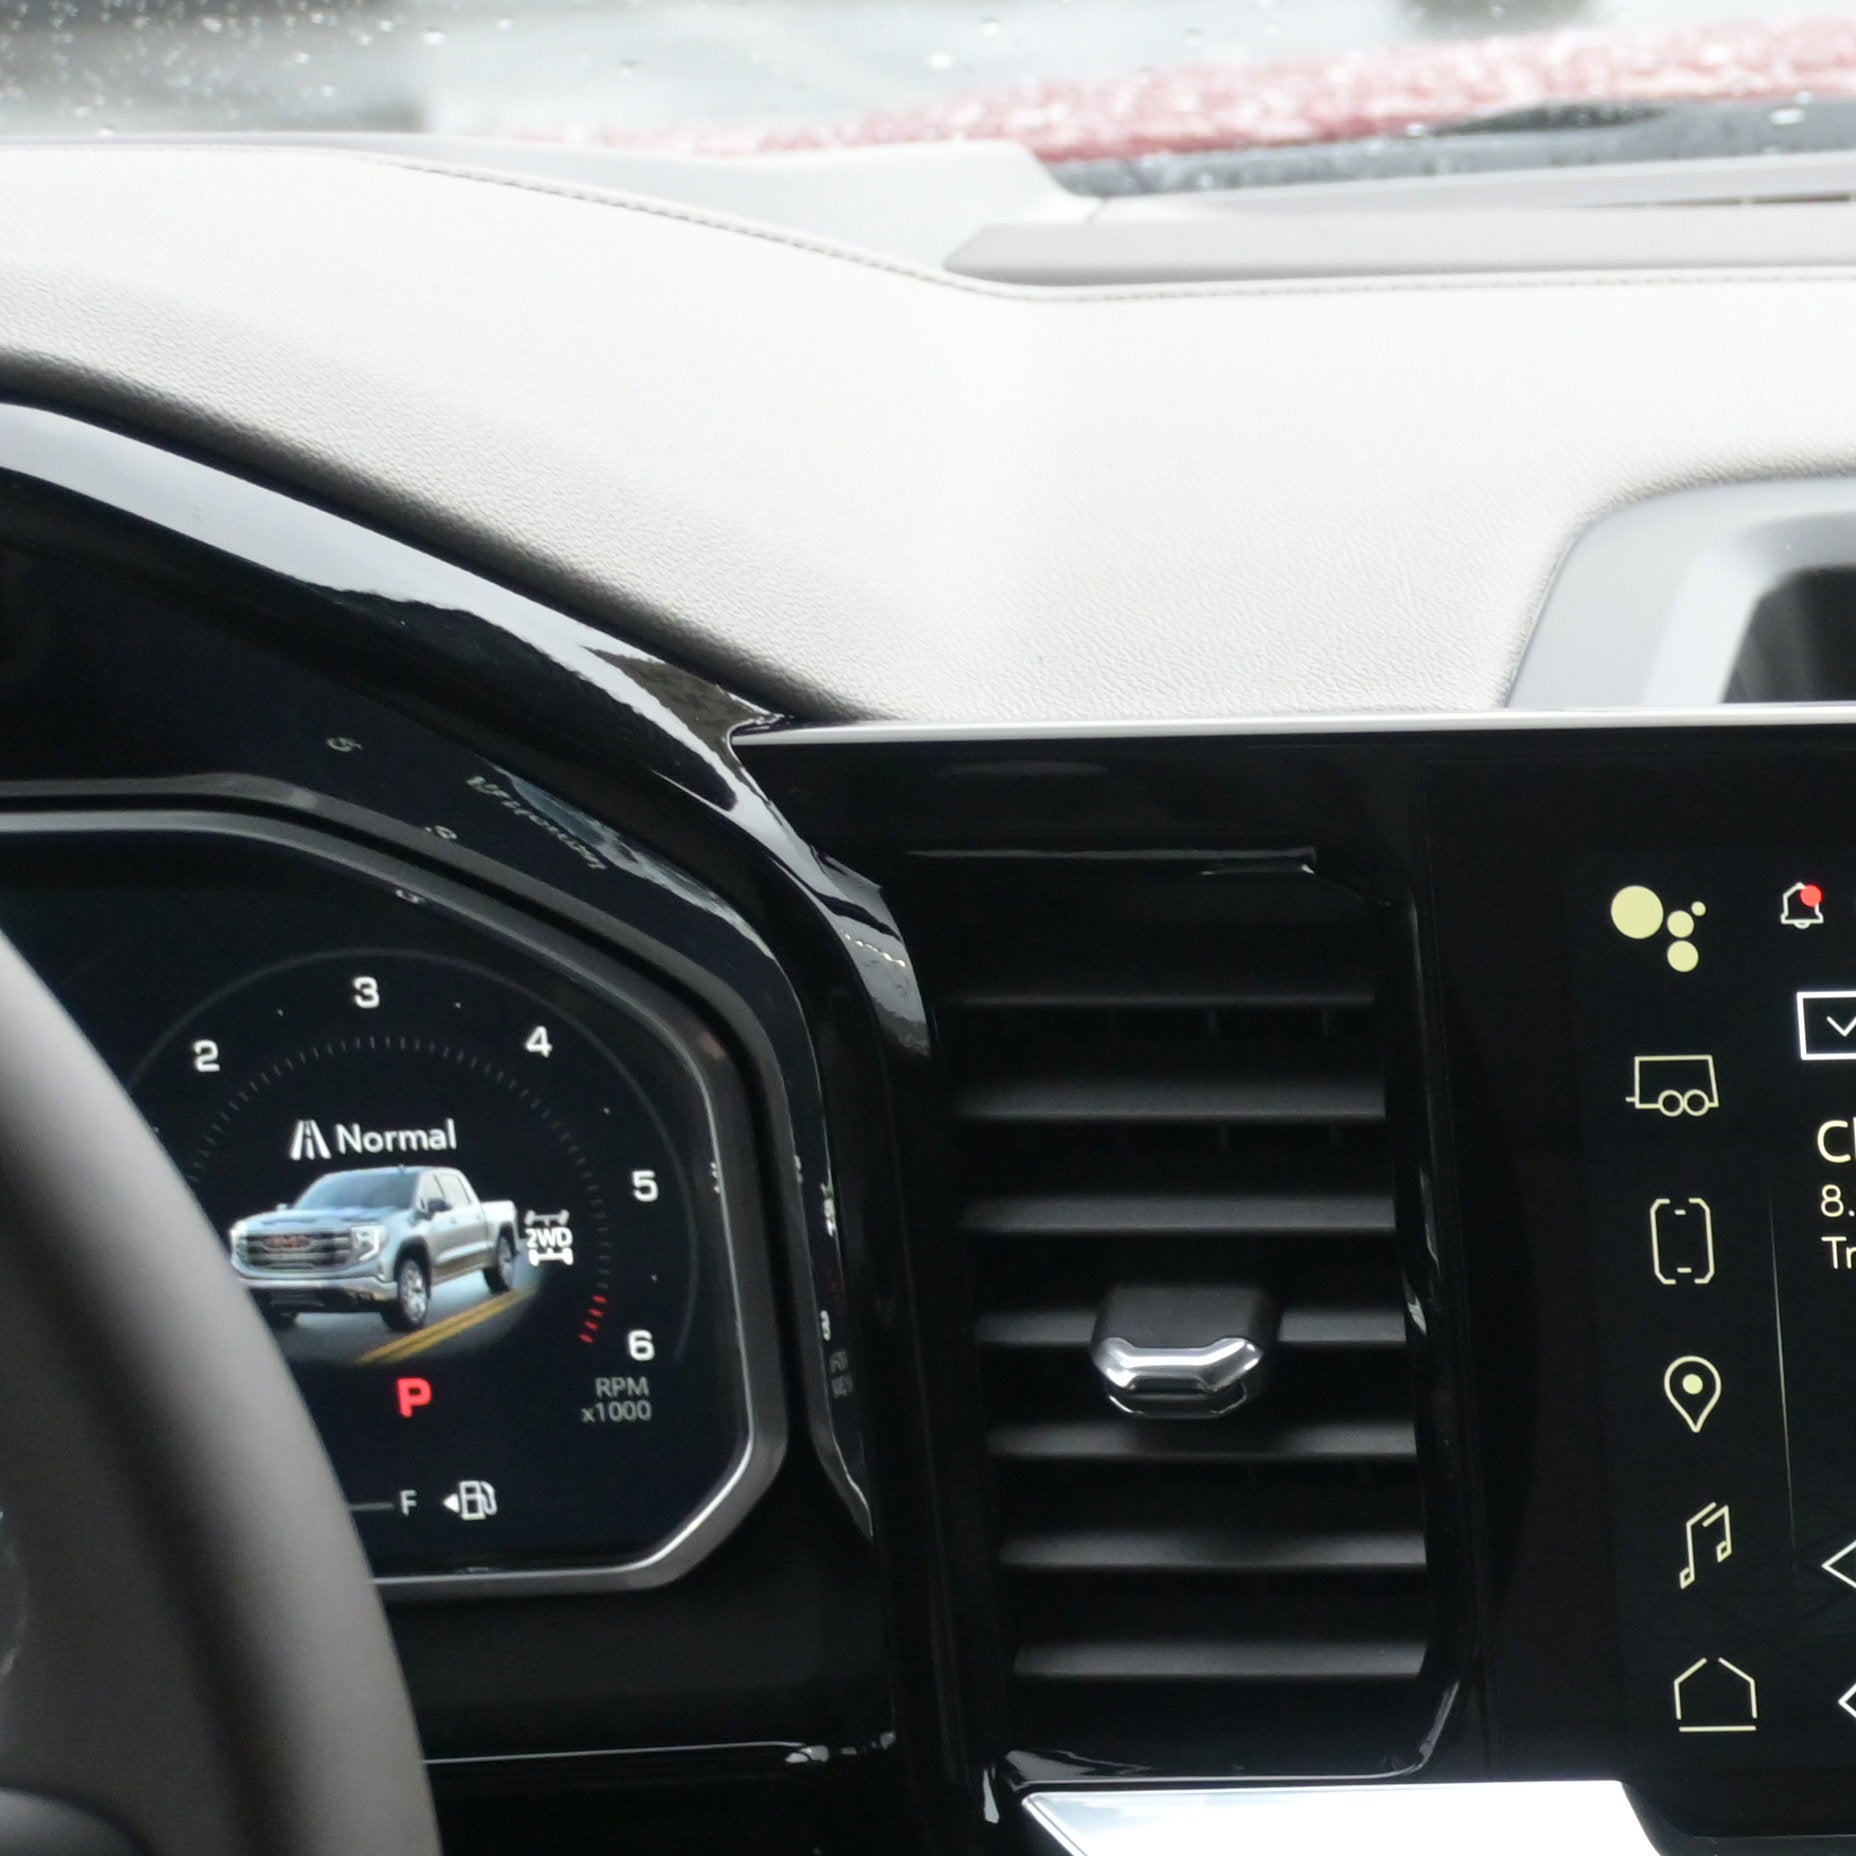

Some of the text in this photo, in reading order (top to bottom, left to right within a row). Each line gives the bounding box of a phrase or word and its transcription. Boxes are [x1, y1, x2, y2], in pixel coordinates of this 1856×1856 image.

[353, 976, 379, 1008] 3
[193, 1040, 219, 1072] 2
[525, 1026, 552, 1057] 4
[336, 1119, 456, 1154] Normal
[632, 1170, 658, 1201] 5
[525, 1228, 573, 1248] 2WD
[628, 1330, 654, 1360] 6
[397, 1378, 432, 1417] P
[594, 1376, 649, 1398] RPM
[581, 1401, 652, 1422] x1000
[400, 1490, 416, 1515] F
